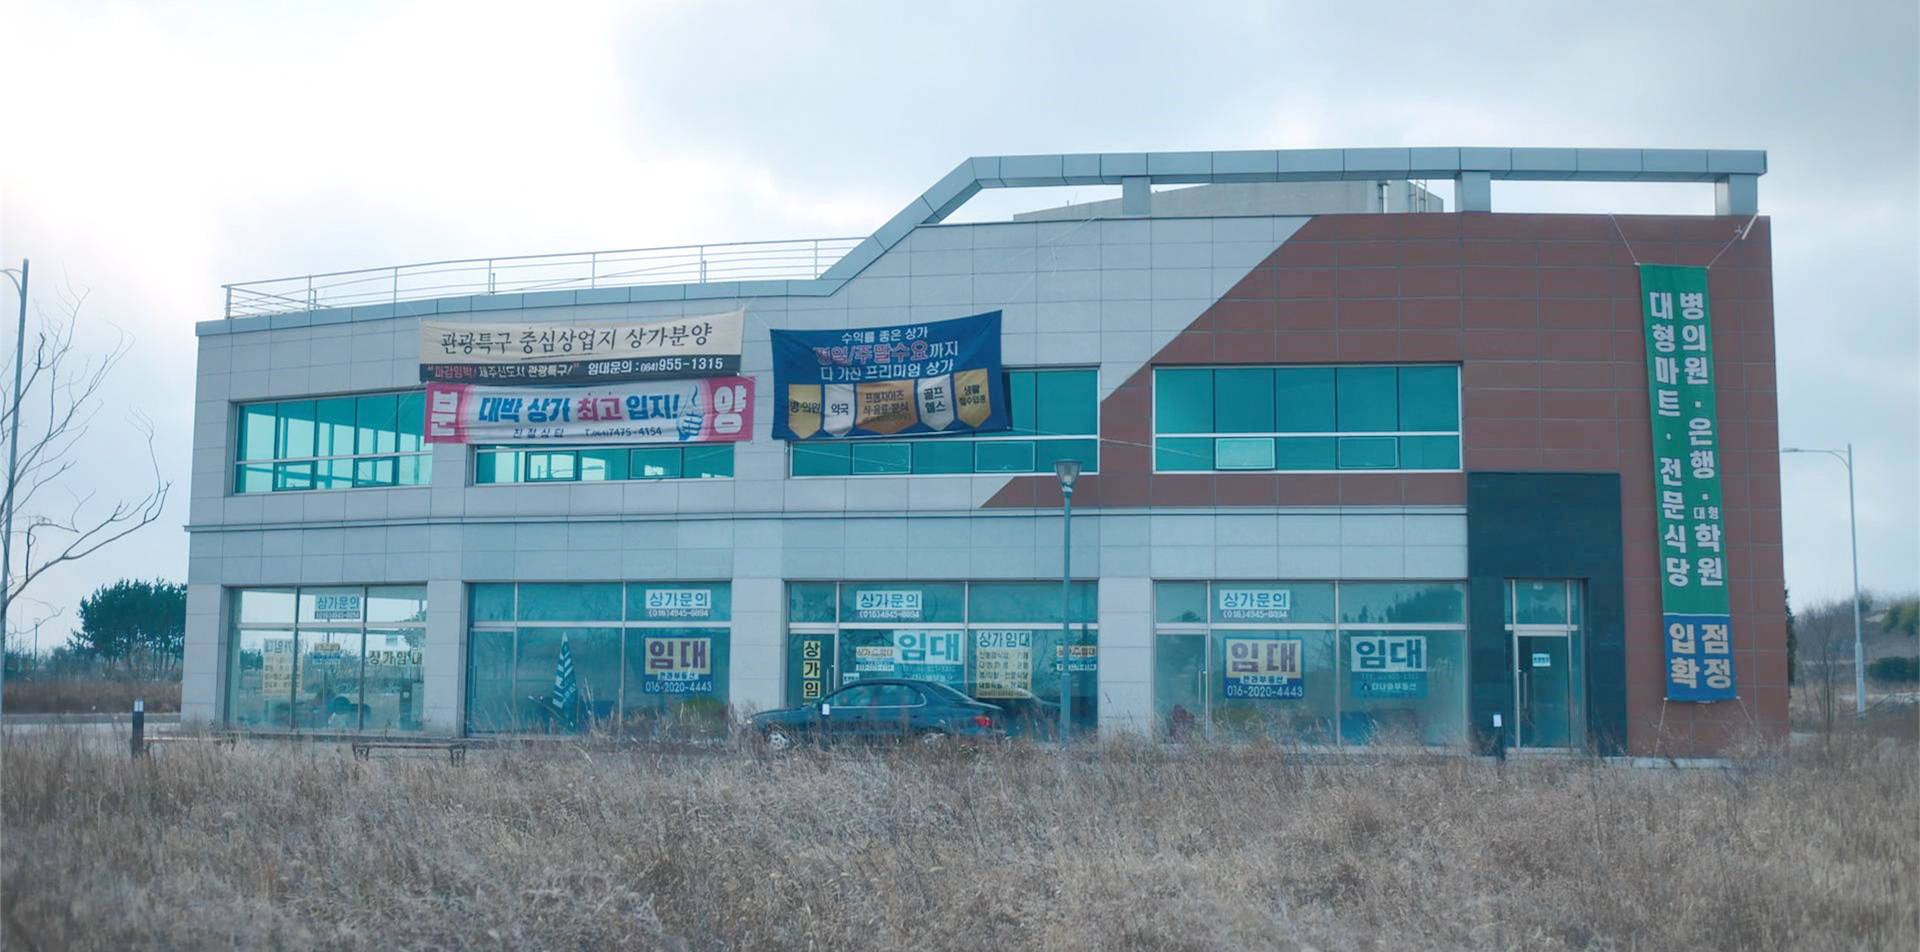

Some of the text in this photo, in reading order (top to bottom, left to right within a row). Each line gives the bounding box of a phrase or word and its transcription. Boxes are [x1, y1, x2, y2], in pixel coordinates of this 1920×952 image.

[440, 322, 713, 354] 관광특구 중심상업지 상가분양
[879, 329, 902, 343] 좋은
[905, 326, 929, 340] 상가
[820, 366, 833, 381] 다
[865, 363, 921, 379] 프리미엄
[926, 359, 954, 376] 상가
[924, 387, 944, 400] 골프
[478, 394, 680, 423] 대박 상가 최고 입지!
[714, 385, 747, 434] 양
[831, 403, 849, 415] 약국
[925, 401, 946, 413] 헬스
[1649, 291, 1690, 588] 대형마트 전문식당
[1679, 292, 1723, 587] 병의원 은행 대형 학원
[317, 596, 360, 610] 상가문의
[650, 592, 708, 607] 상가문의
[860, 593, 919, 609] 상가문의
[1224, 592, 1286, 609] 상가문의
[899, 633, 959, 661] 임대
[980, 632, 1030, 648] 상가임대
[1669, 623, 1729, 655] 입점
[370, 651, 422, 665] 상가임대
[650, 640, 706, 669] 임대
[1230, 643, 1296, 673] 임대
[1356, 639, 1422, 669] 임대
[1670, 657, 1731, 689] 확정
[645, 681, 712, 693] 016-2020-4443
[1227, 685, 1303, 697] 016-2020-4443
